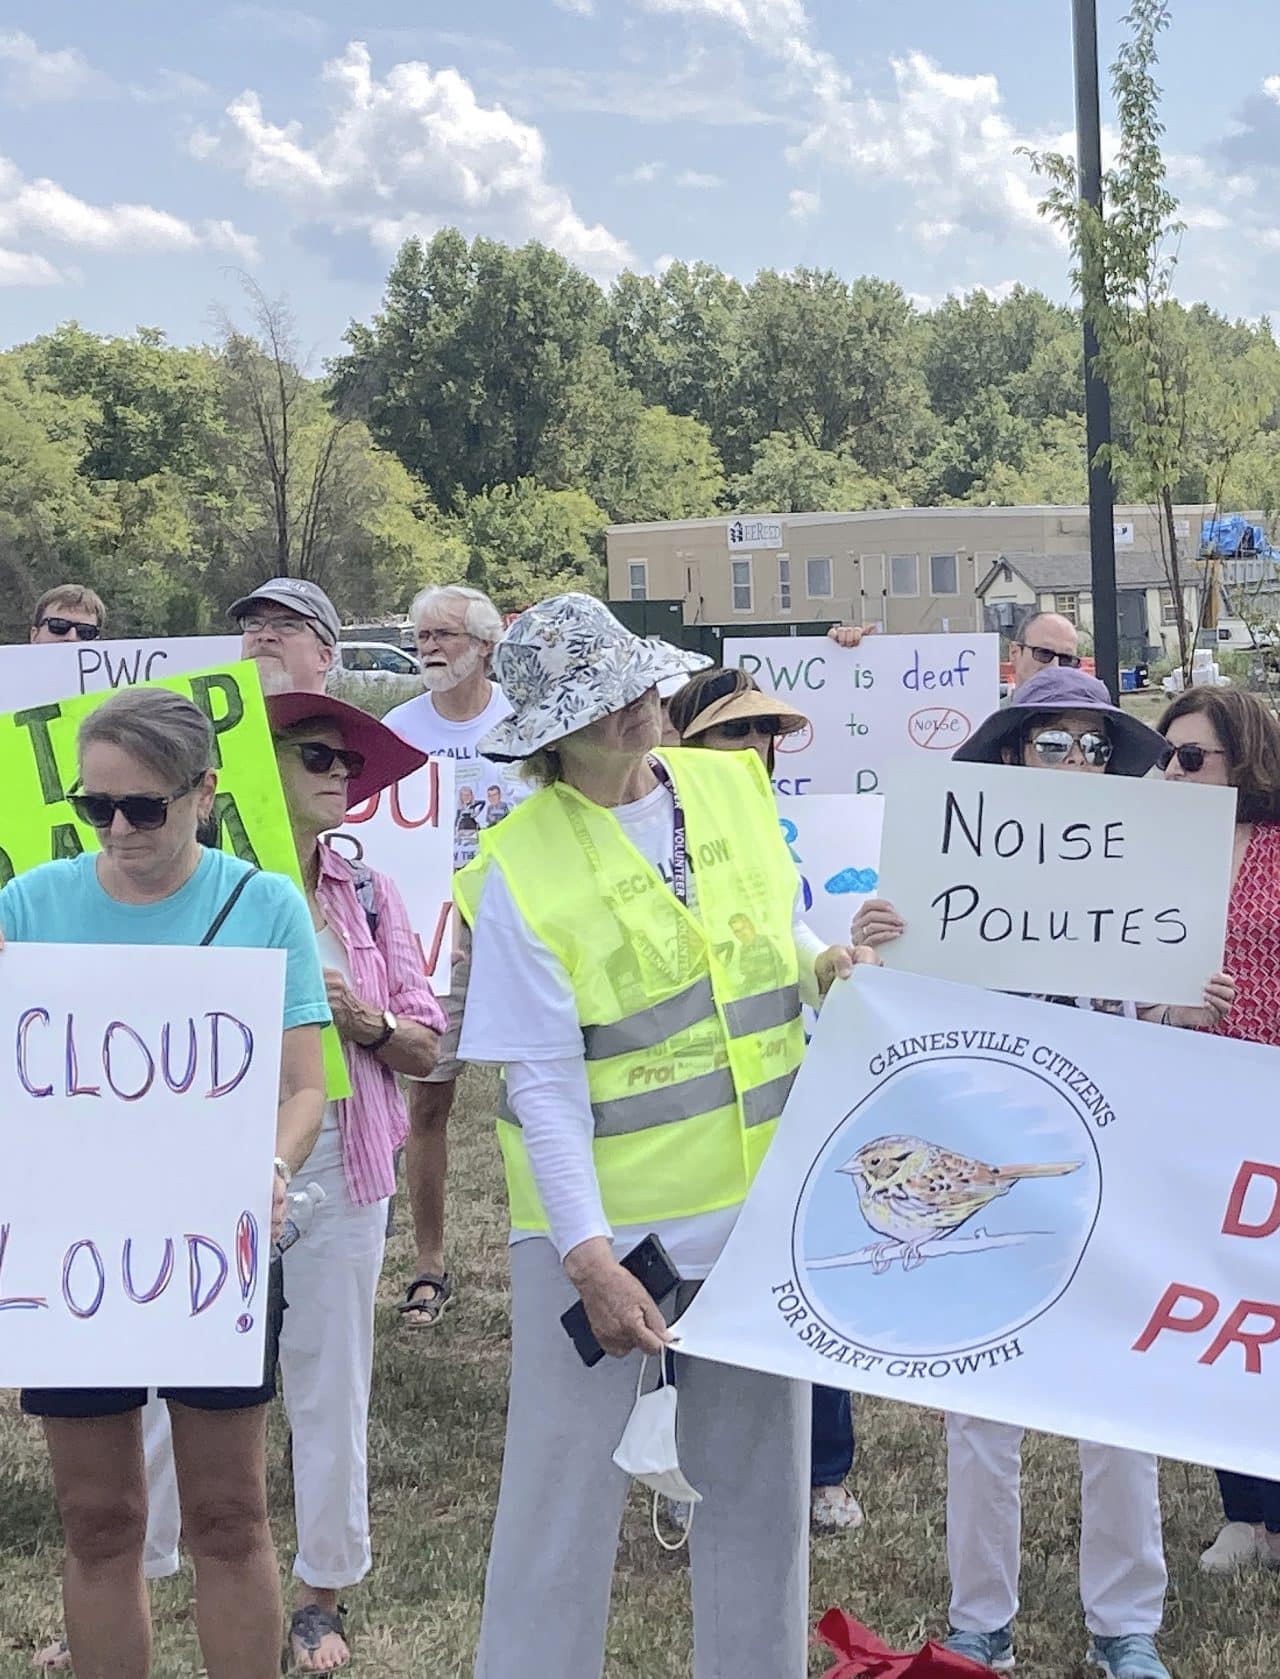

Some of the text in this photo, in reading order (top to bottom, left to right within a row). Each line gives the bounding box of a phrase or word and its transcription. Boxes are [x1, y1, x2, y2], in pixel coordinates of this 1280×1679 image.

[78, 648, 168, 695] PWC
[738, 650, 976, 691] PWC is deaf
[845, 712, 869, 737] to
[674, 827, 686, 897] VOLUNTEER
[941, 791, 1125, 864] NOISE
[931, 884, 1187, 945] POLUTES
[16, 1007, 255, 1102] CLOUD
[868, 1031, 1116, 1128] GAINESVILLE CITIZENS
[0, 1210, 258, 1333] LOUD!
[771, 1280, 1025, 1379] FOR SMART GROWTH
